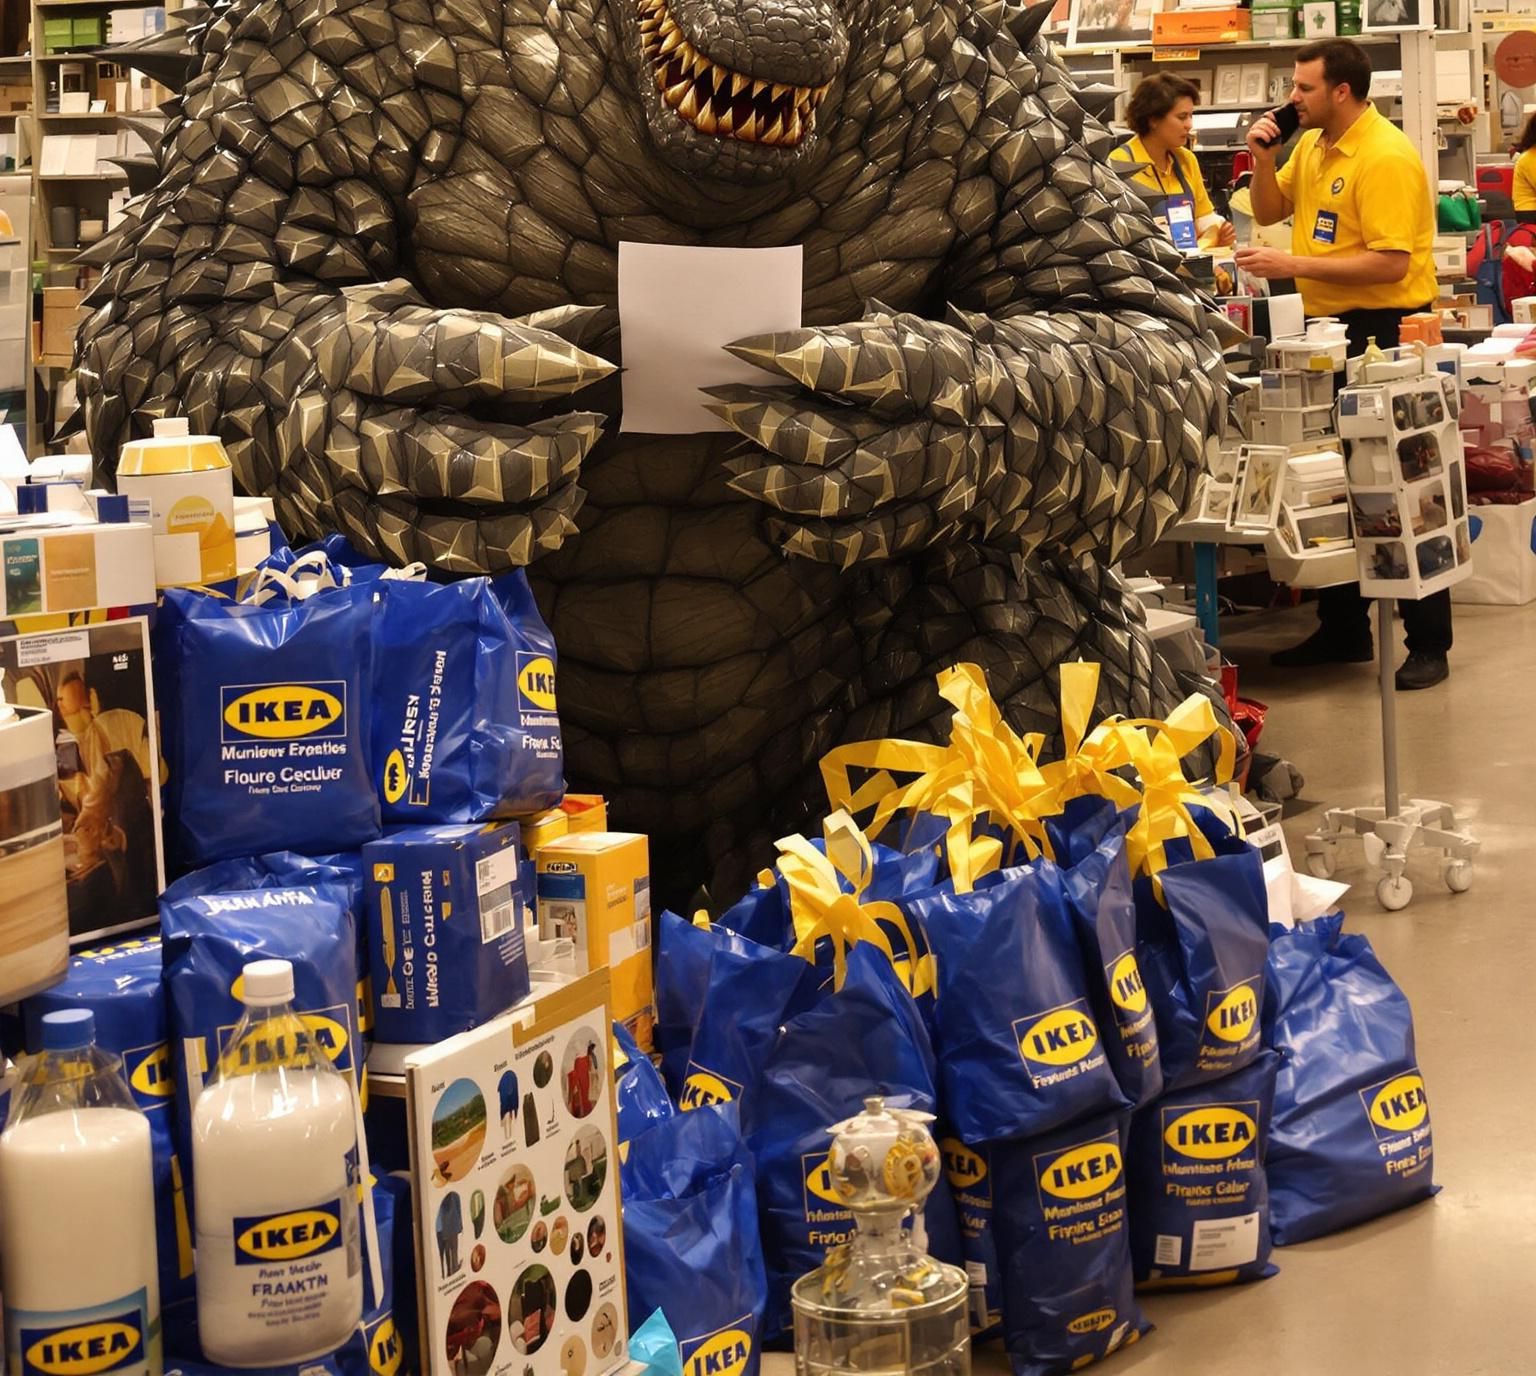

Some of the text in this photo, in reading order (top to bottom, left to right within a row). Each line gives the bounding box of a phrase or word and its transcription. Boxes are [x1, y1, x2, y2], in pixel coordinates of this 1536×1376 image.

[527, 672, 556, 694] IKE
[239, 699, 332, 723] IKEA
[1032, 1019, 1095, 1056] IKEA
[1380, 1087, 1426, 1120] IKEA
[1178, 1121, 1250, 1146] IKEA
[945, 1151, 979, 1177] KEA
[1053, 1153, 1118, 1188] IKEA
[252, 1219, 331, 1250] IKEA
[43, 1331, 129, 1364] IKEA
[694, 1340, 747, 1376] IKEA
